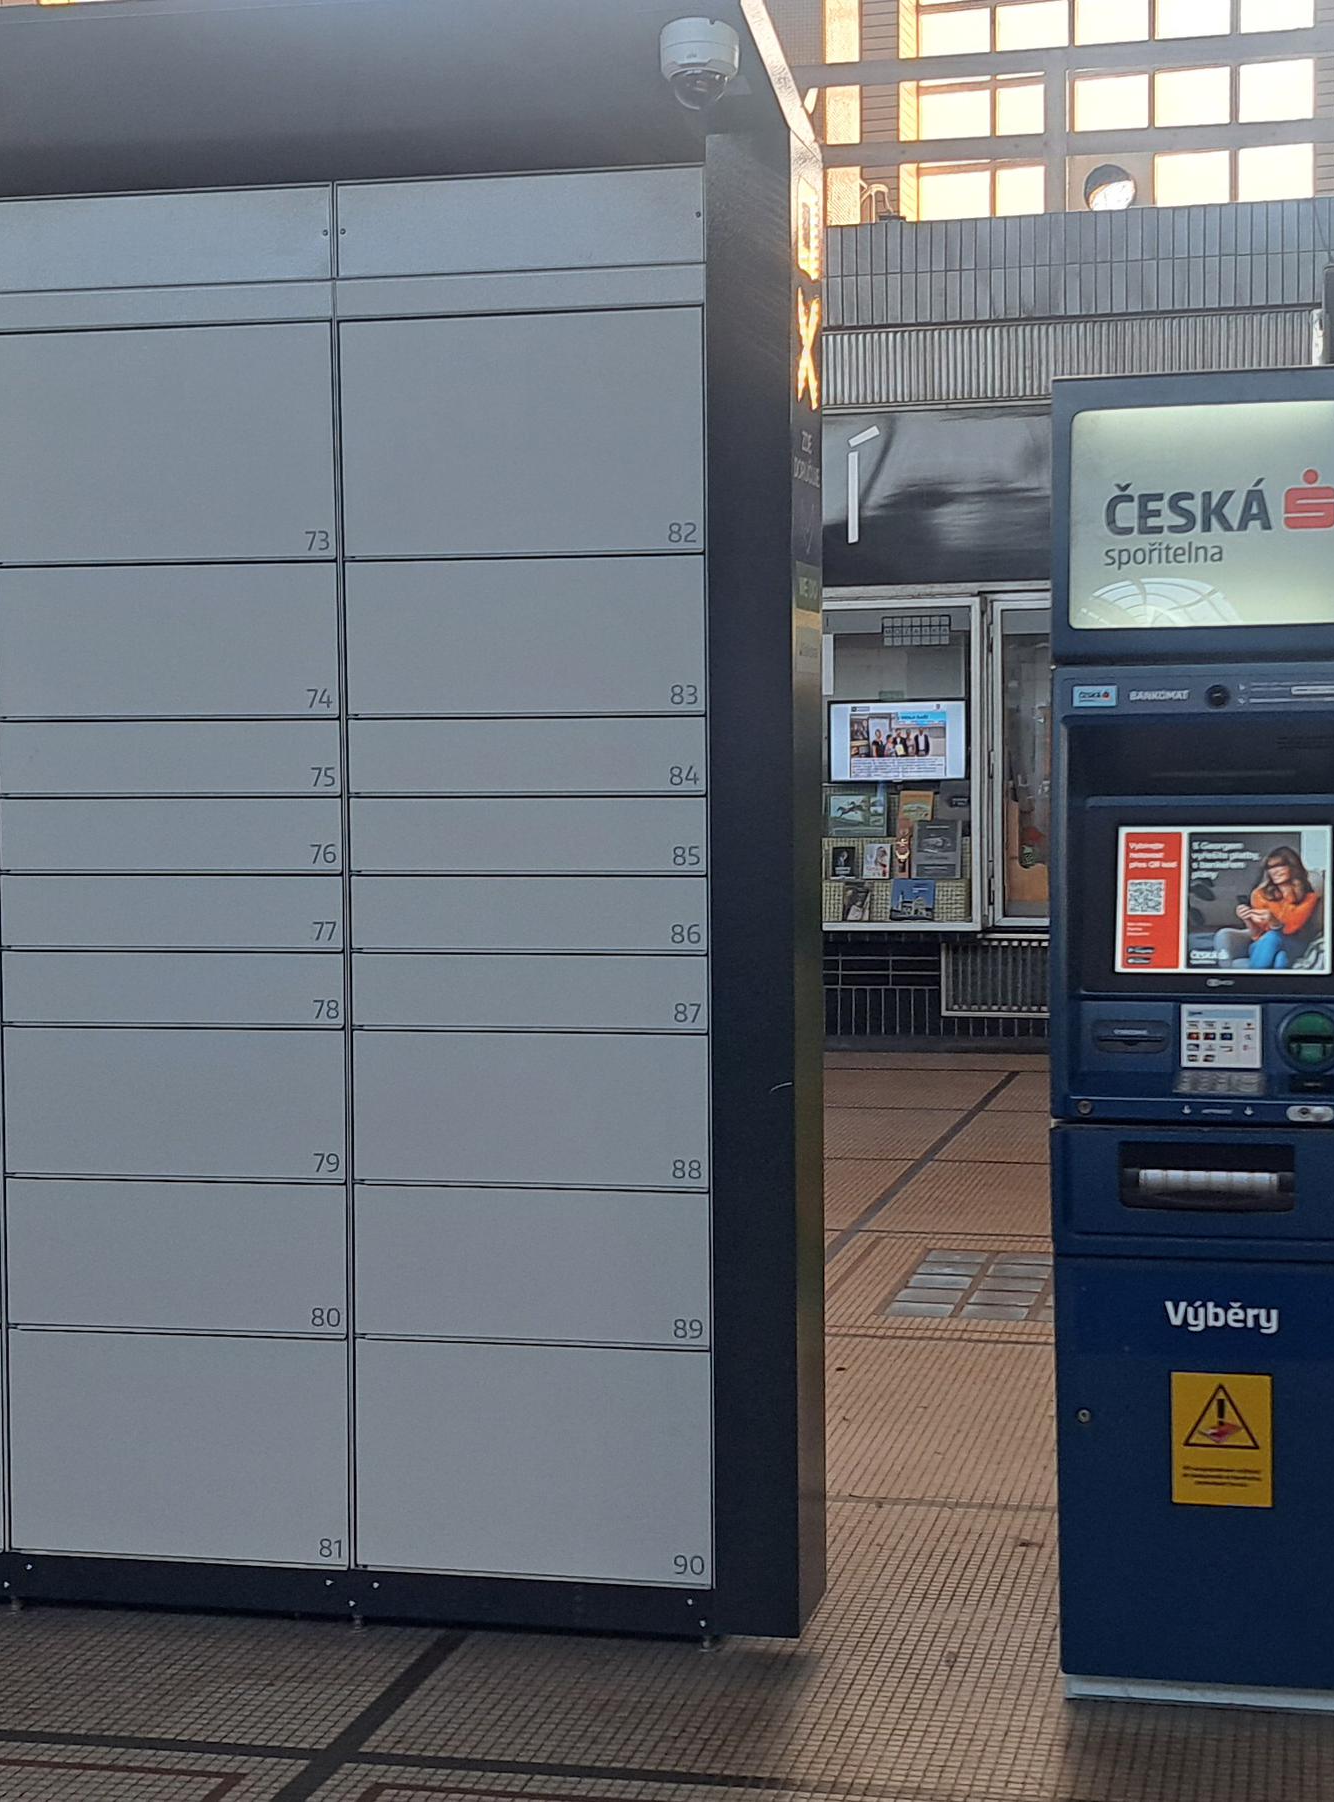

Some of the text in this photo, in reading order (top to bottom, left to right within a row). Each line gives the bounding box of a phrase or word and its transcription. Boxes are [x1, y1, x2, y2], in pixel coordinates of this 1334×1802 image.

[1104, 477, 1273, 536] ČESKÁ
[304, 530, 330, 552] 73
[667, 522, 697, 544] 82
[1104, 541, 1224, 571] spořitelna
[306, 687, 333, 709] 74
[670, 684, 698, 705] 83
[310, 766, 336, 788] 75
[669, 764, 700, 787] 84
[309, 843, 337, 865] 76
[672, 845, 701, 867] 85
[312, 920, 337, 942] 77
[670, 923, 702, 945] 86
[312, 999, 340, 1020] 78
[673, 1002, 702, 1024] 87
[312, 1152, 340, 1173] 79
[672, 1159, 702, 1180] 88
[311, 1307, 341, 1328] 80
[1165, 1300, 1279, 1334] Výběry
[673, 1318, 704, 1340] 89
[319, 1537, 342, 1559] 81
[673, 1554, 705, 1576] 90
